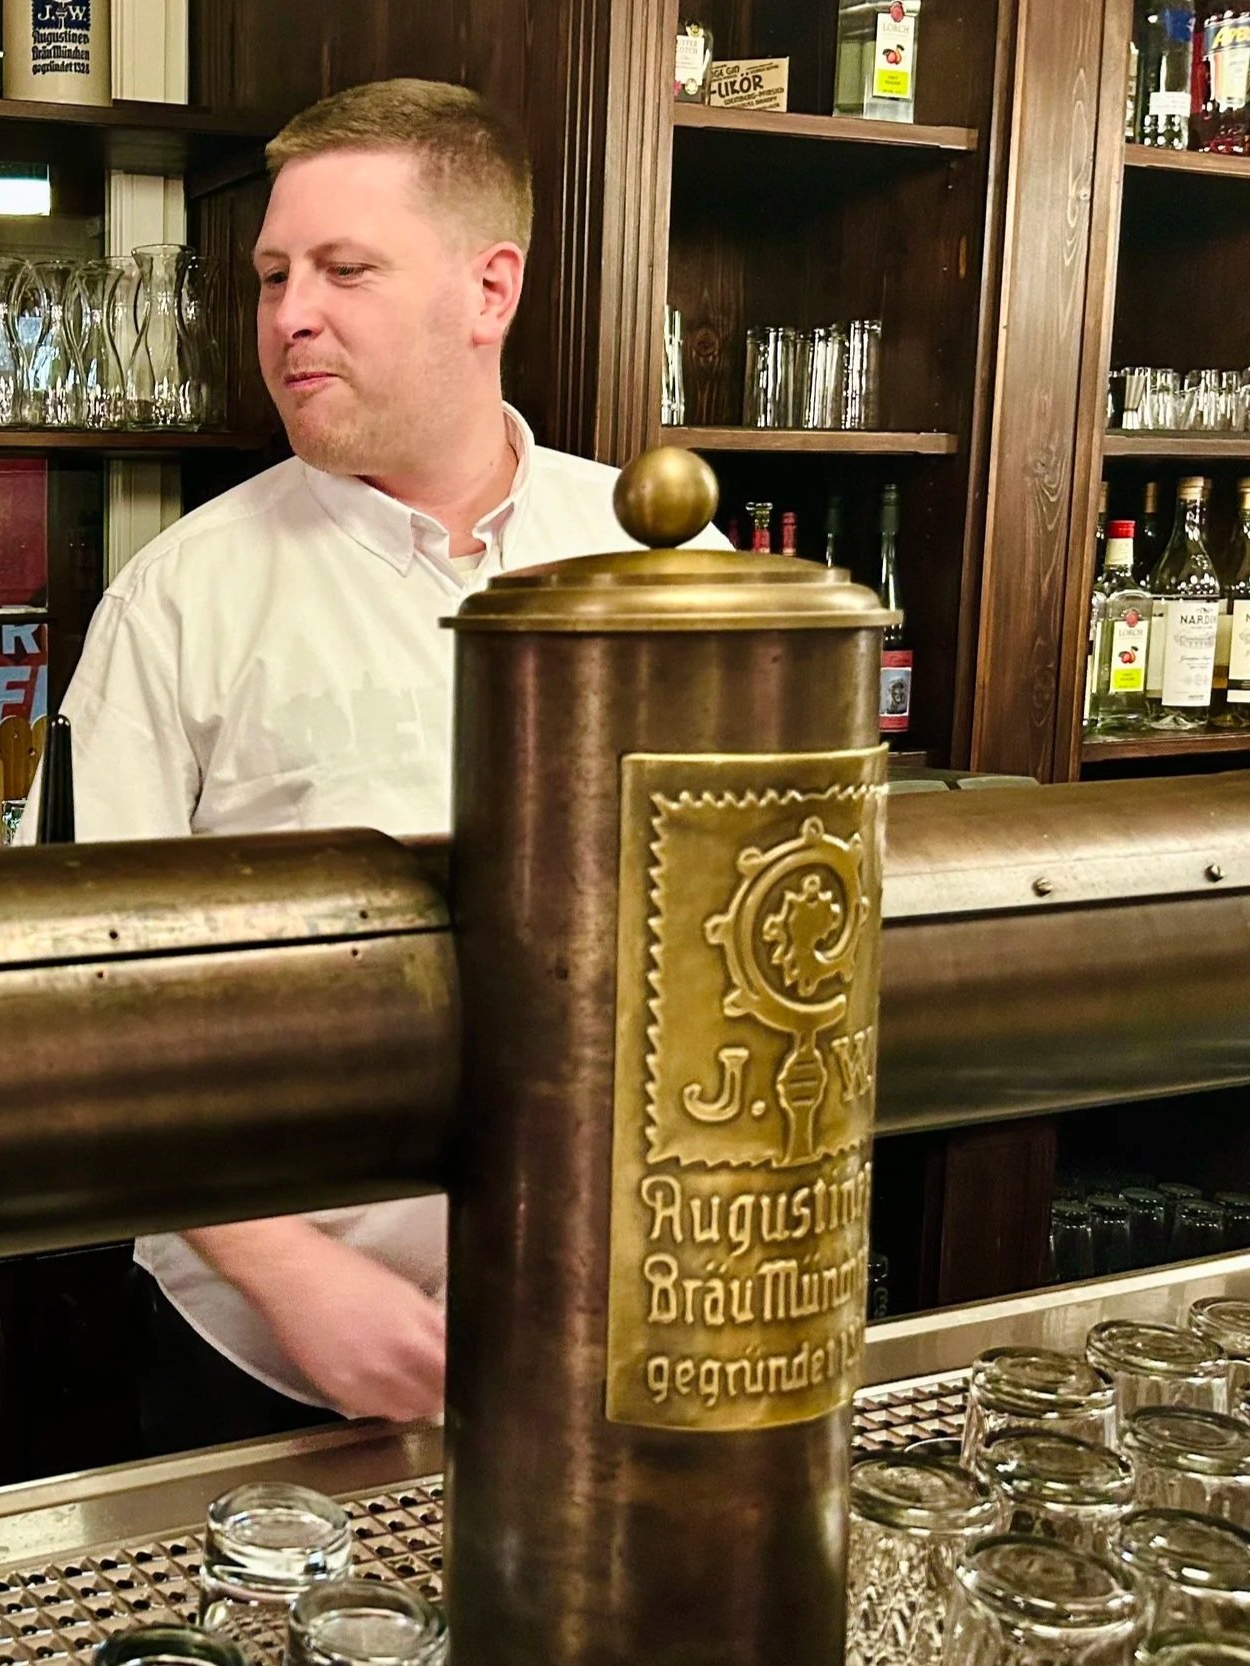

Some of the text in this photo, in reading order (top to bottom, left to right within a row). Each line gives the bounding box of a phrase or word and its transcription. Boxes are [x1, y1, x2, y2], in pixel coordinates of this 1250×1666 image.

[32, 61, 89, 75] gegründet 1328
[683, 1047, 766, 1121] J.
[644, 1254, 754, 1326] Bräu
